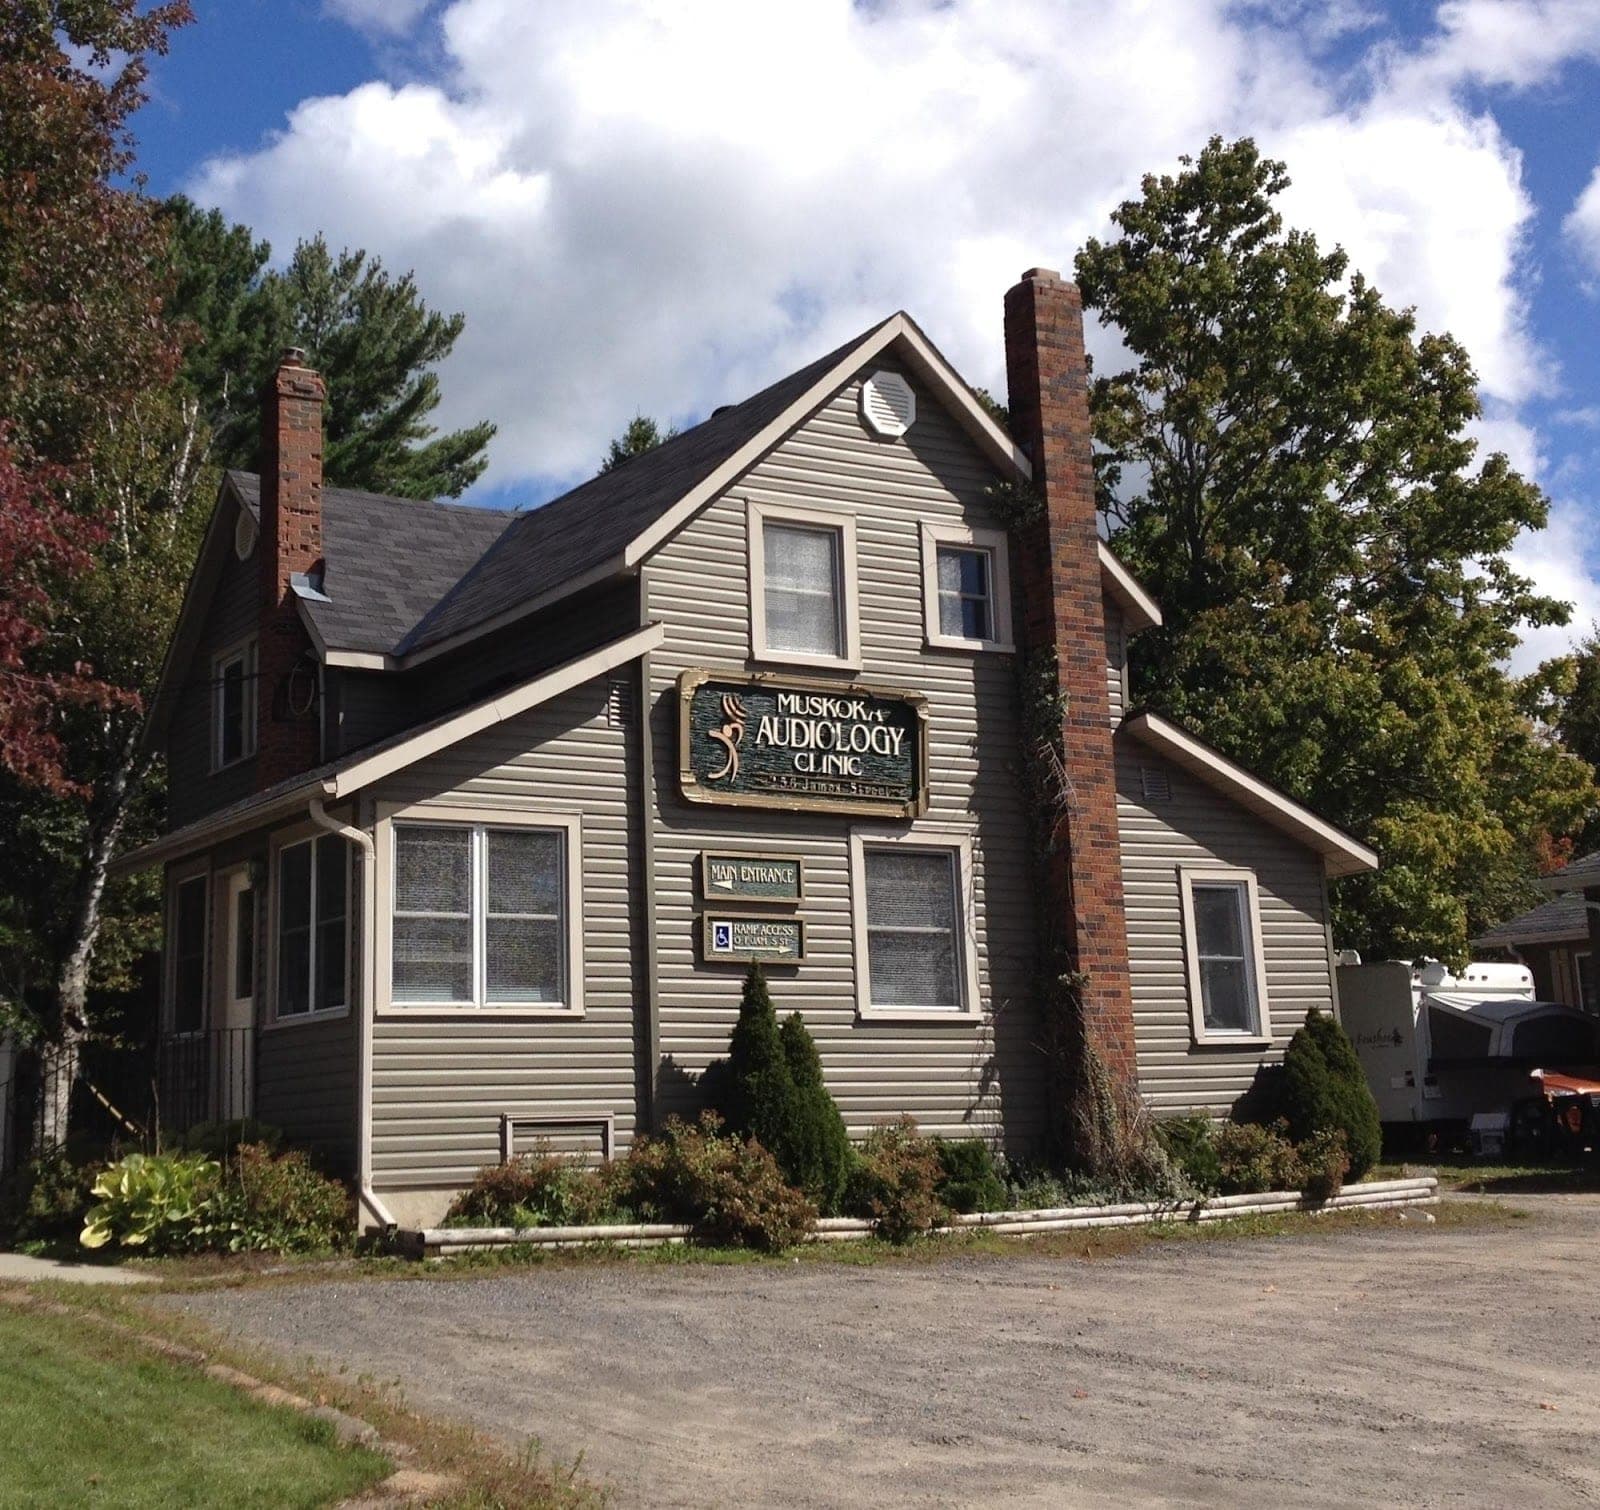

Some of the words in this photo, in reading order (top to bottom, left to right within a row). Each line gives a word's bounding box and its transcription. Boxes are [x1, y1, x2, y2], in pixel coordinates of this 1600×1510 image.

[777, 693, 885, 722] MUSKOKA
[755, 716, 905, 756] AUDIOLOGY
[794, 752, 863, 777] CLINIC
[711, 864, 738, 881] MAIN
[741, 866, 794, 883] ENTRANCE
[734, 922, 759, 935] RAMP
[760, 924, 793, 937] ACCESS
